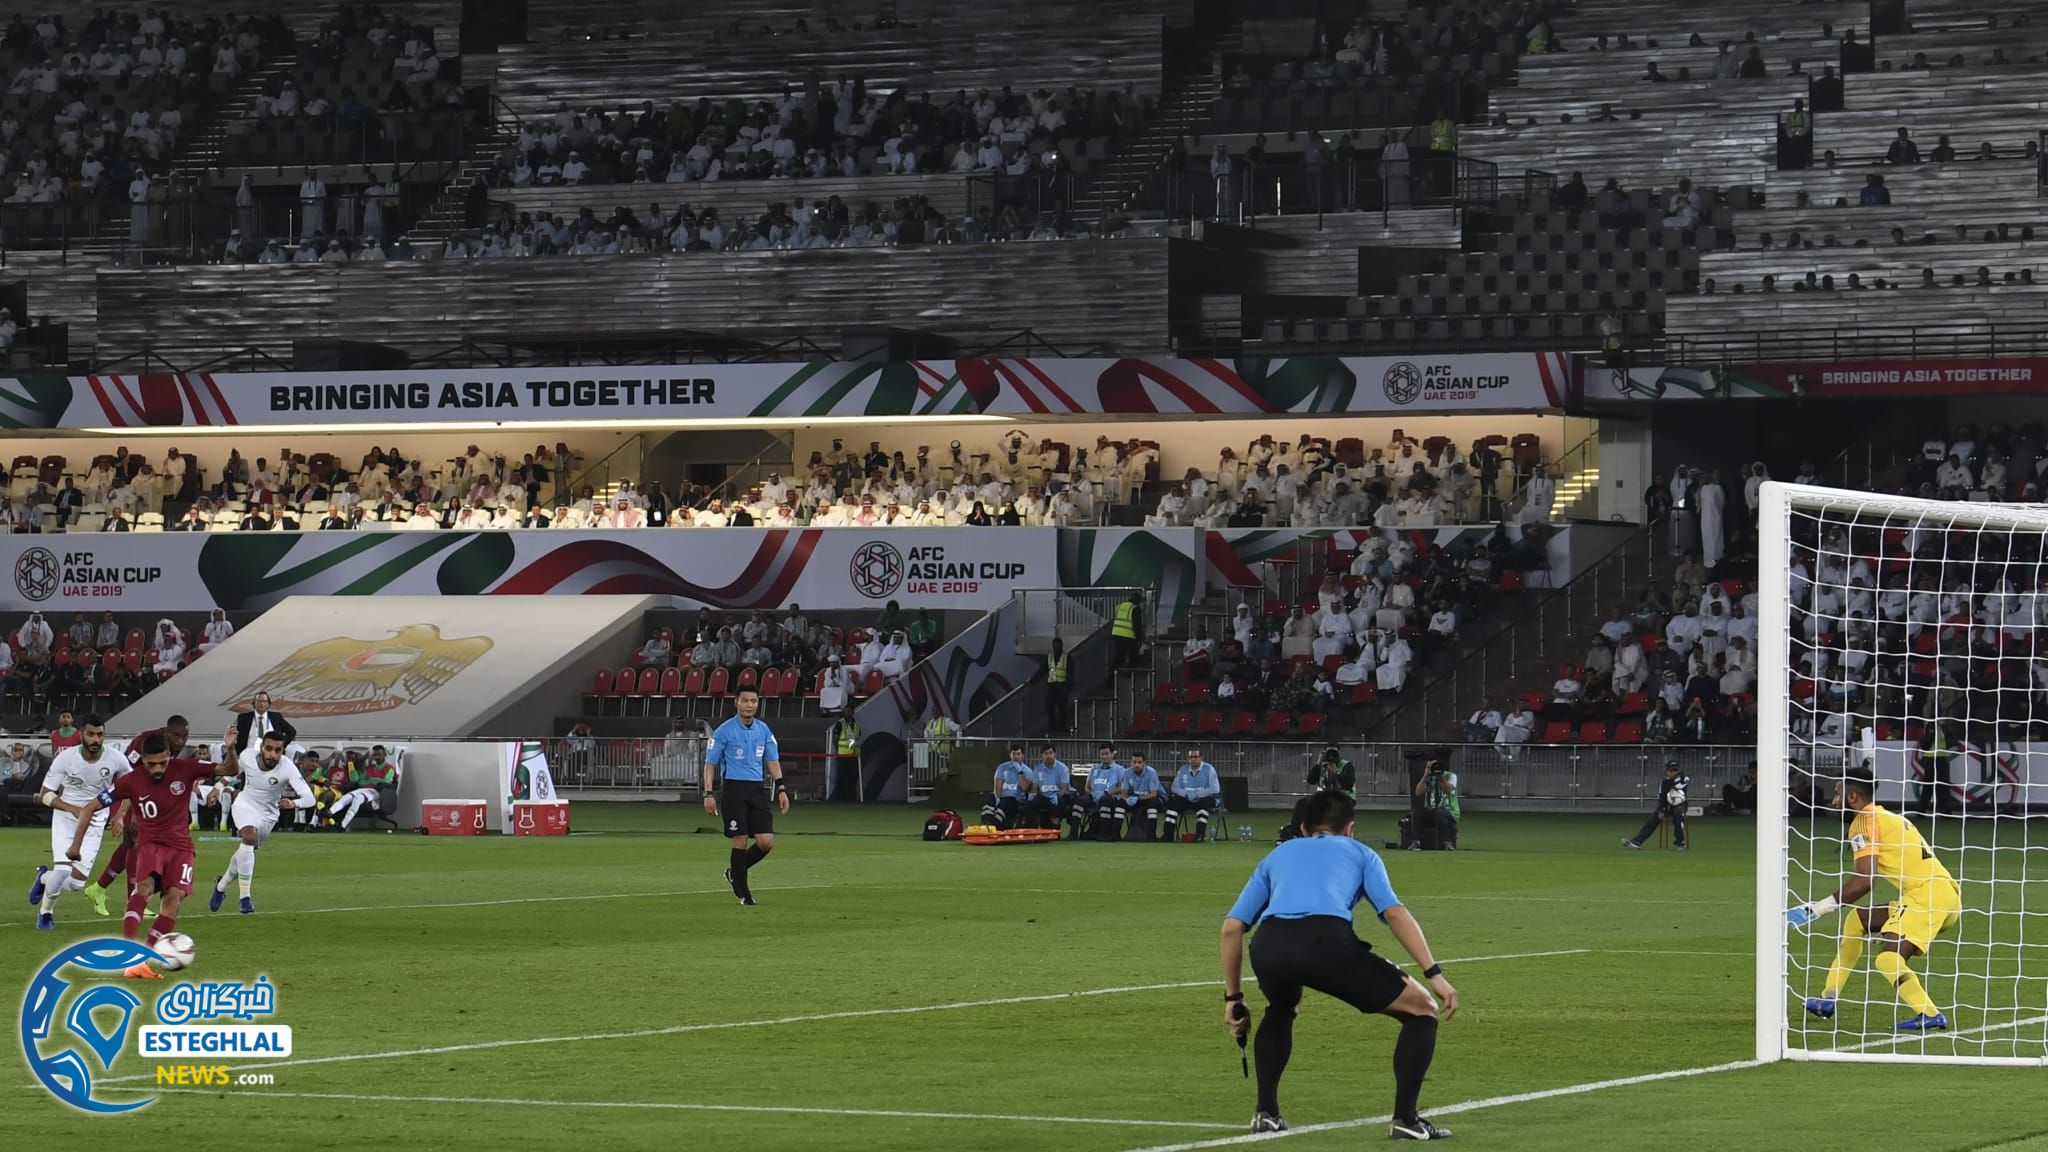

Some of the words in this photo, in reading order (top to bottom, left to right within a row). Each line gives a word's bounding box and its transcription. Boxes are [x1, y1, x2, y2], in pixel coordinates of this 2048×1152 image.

[1425, 365, 1452, 377] AFC
[1822, 372, 1900, 385] BRINGING
[1903, 370, 1941, 383] ASIA
[1945, 368, 2032, 382] TOGETHER
[1424, 377, 1473, 390] ASIAN
[1477, 376, 1510, 389] CUP
[270, 383, 430, 411] BRINGING
[437, 382, 520, 409] ASIA
[526, 379, 716, 408] TOGETHER
[1424, 391, 1447, 400] UAE
[1449, 390, 1477, 400] 2019
[64, 552, 94, 566] AFC
[908, 547, 945, 561] AFC
[63, 567, 119, 583] ASIAN
[124, 567, 161, 583] CUP
[907, 563, 975, 579] ASIAN
[980, 563, 1025, 579] CUP
[63, 586, 88, 596] UAE
[92, 585, 123, 596] 2019
[907, 582, 938, 593] UAE
[942, 582, 978, 593] 2019
[139, 801, 158, 818] 10
[181, 863, 193, 883] 10
